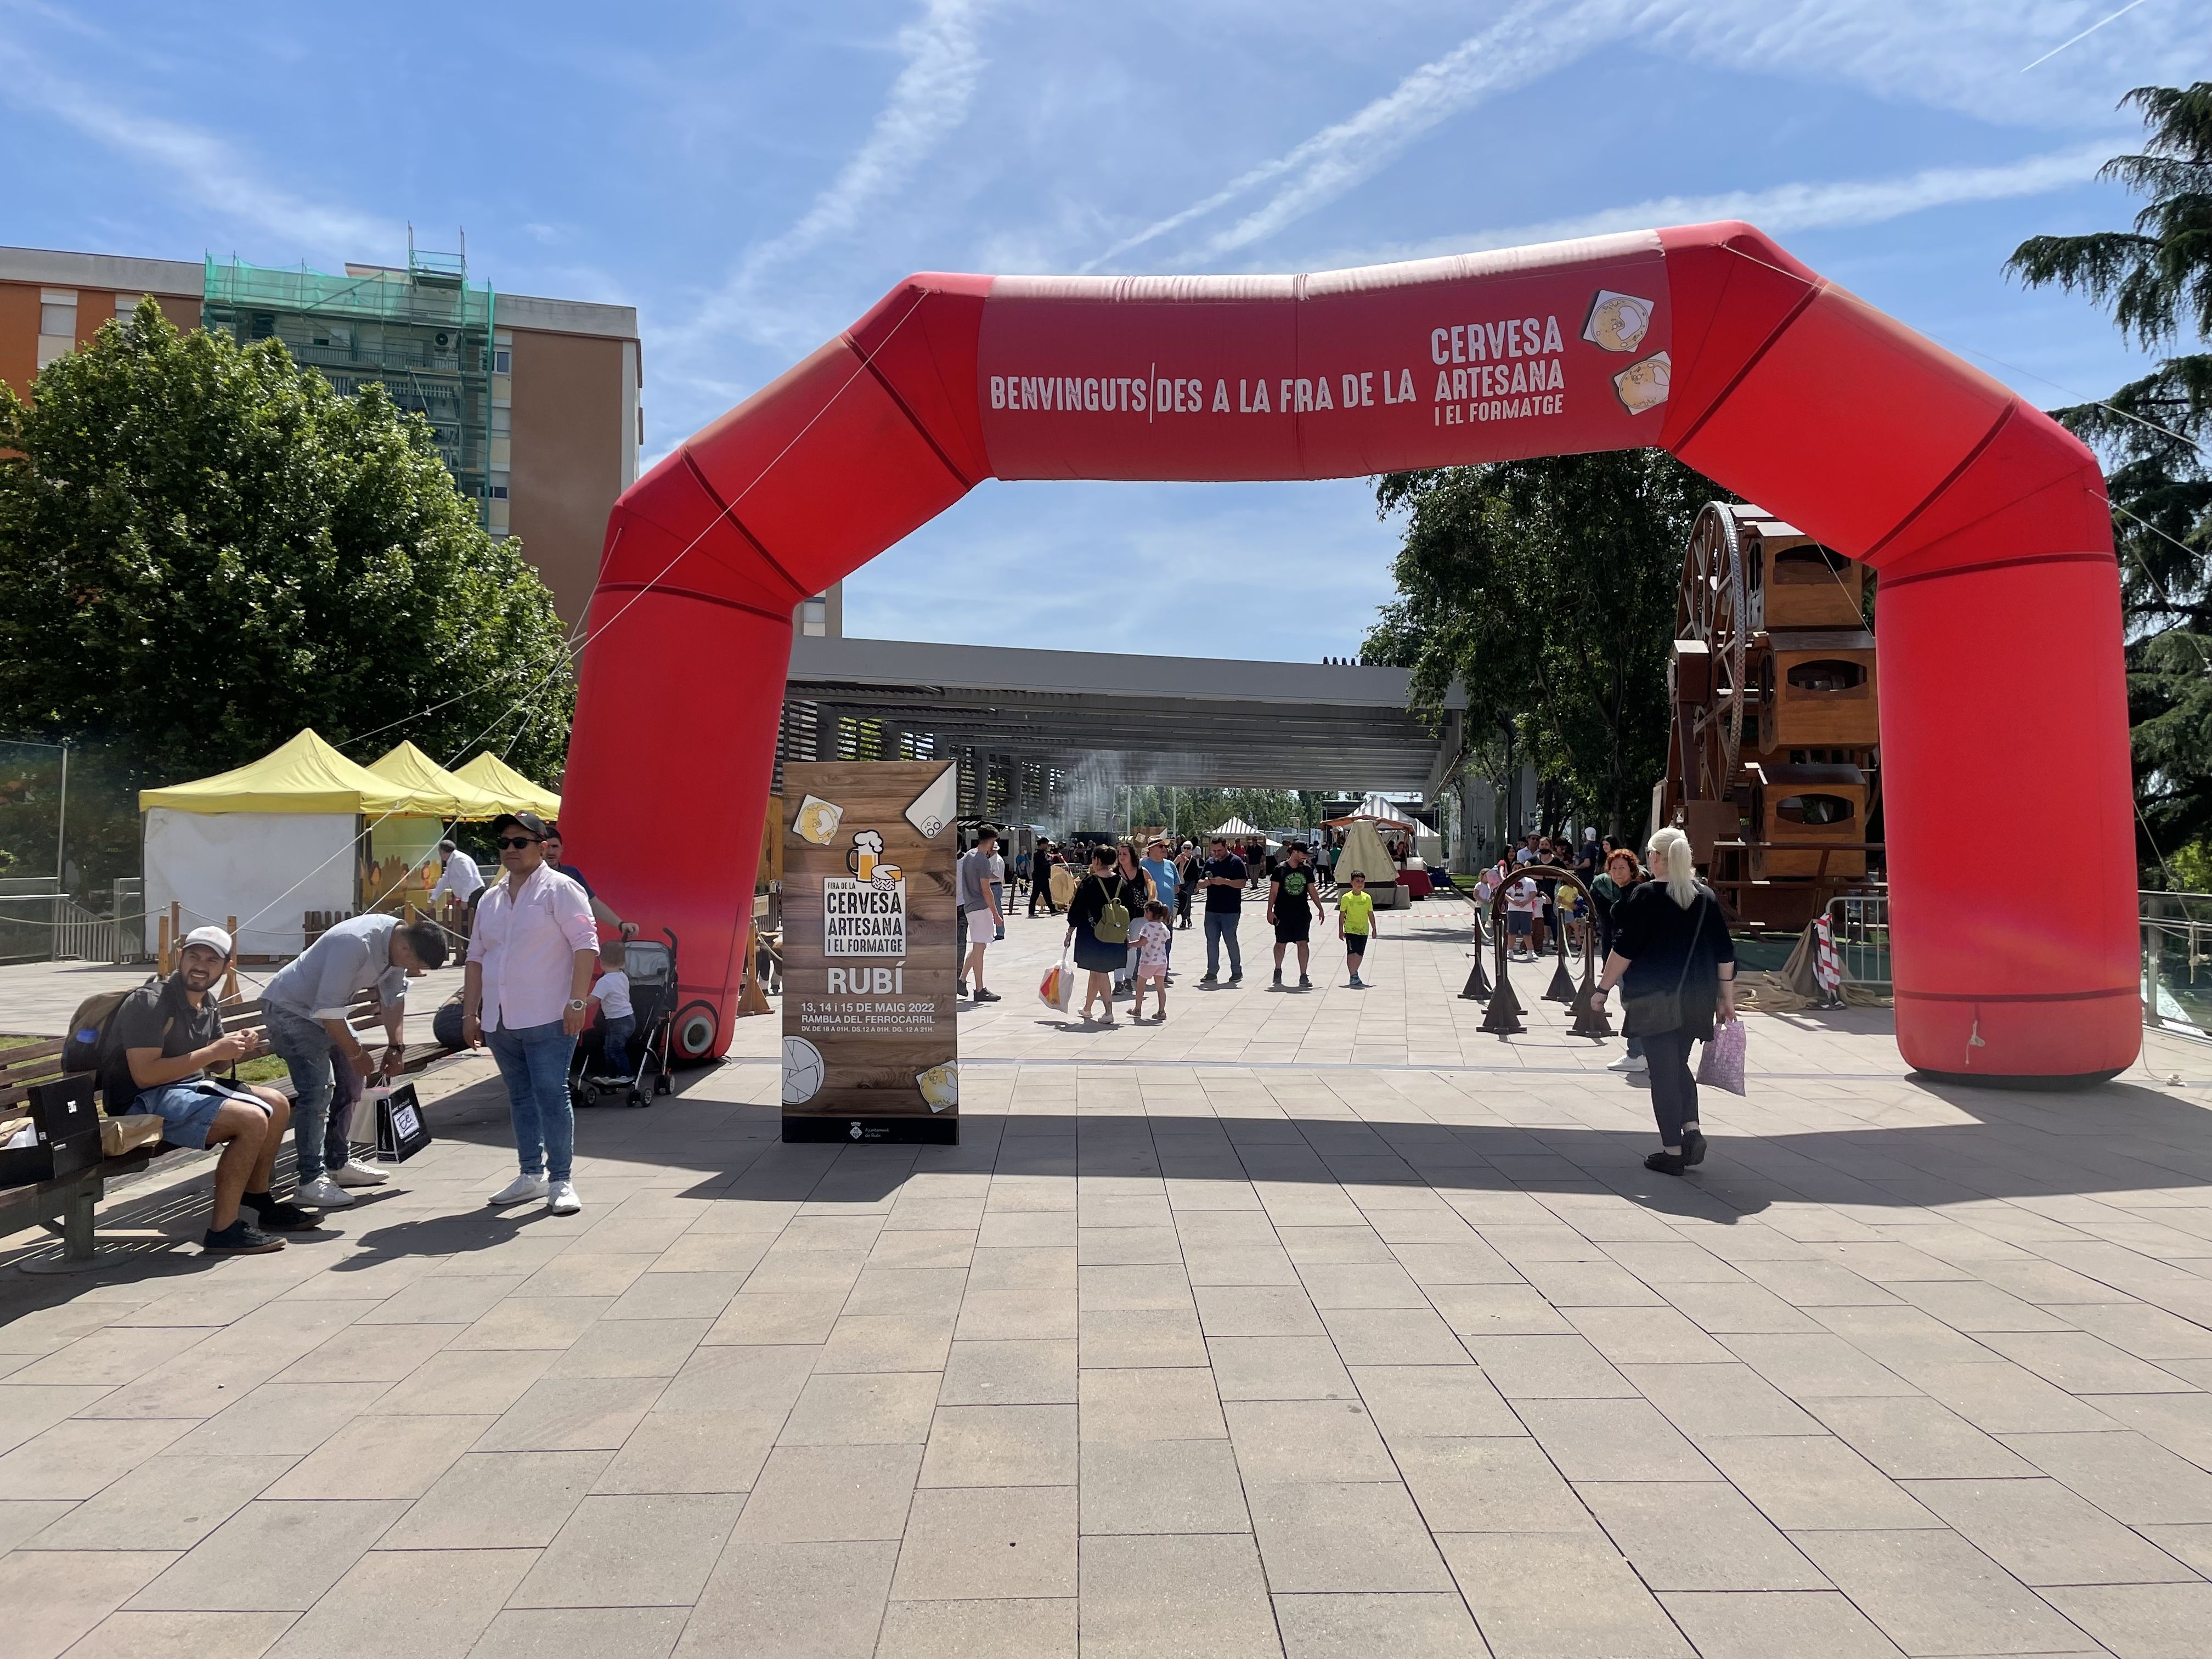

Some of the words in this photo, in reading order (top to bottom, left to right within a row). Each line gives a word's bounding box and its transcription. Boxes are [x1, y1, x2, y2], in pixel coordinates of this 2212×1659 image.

[1431, 315, 1564, 365] CERVESA
[1212, 379, 1231, 413] A
[1240, 379, 1271, 413] LA
[1342, 372, 1374, 408] DE
[1383, 368, 1417, 404] LA
[1434, 359, 1565, 402] ARTESANA
[1435, 407, 1440, 426] I
[1446, 404, 1464, 425] EL
[1469, 393, 1564, 422] FORMATGE
[827, 892, 902, 914] CERVESA
[828, 917, 902, 936] ARTESANA
[828, 939, 831, 952] I
[834, 939, 844, 952] EL
[848, 939, 902, 952] FORMATGE
[827, 961, 906, 995] RUBÍ
[801, 1003, 816, 1013] 13,
[820, 1003, 832, 1012] 14
[834, 1003, 837, 1012] i
[840, 1003, 853, 1012] 15
[856, 1003, 872, 1012] DE
[875, 1003, 905, 1012] MAIG
[909, 1003, 935, 1012] 2022
[802, 1015, 841, 1024] RAMBLA
[844, 1015, 864, 1024] DEL
[865, 1015, 935, 1024] FERROCARRIL
